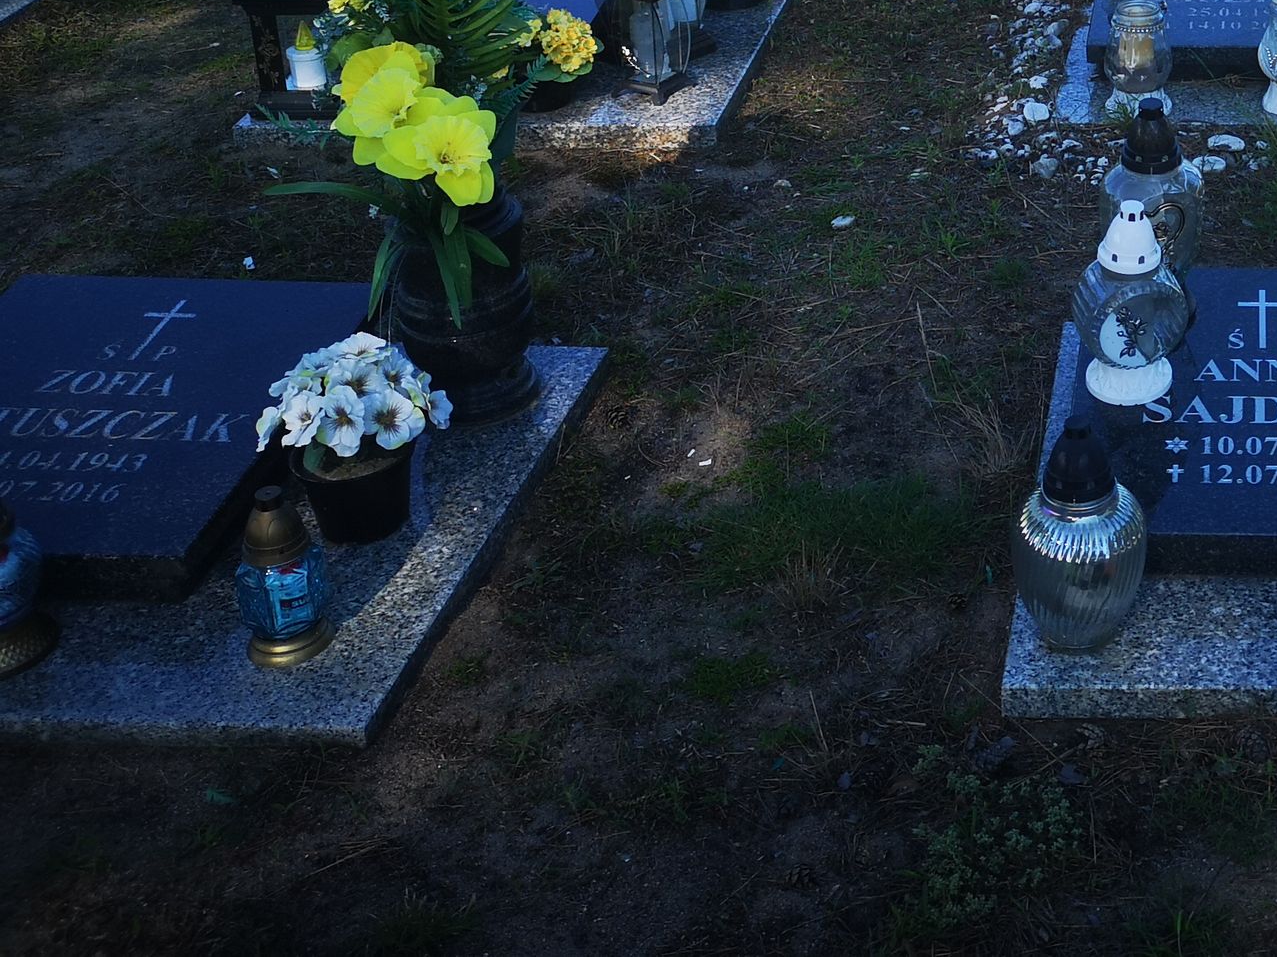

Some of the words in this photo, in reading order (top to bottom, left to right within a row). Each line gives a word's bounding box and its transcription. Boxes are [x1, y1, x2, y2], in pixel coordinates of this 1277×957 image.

[1227, 328, 1245, 349] Ś
[152, 345, 177, 361] P
[33, 369, 176, 397] ZOFIA
